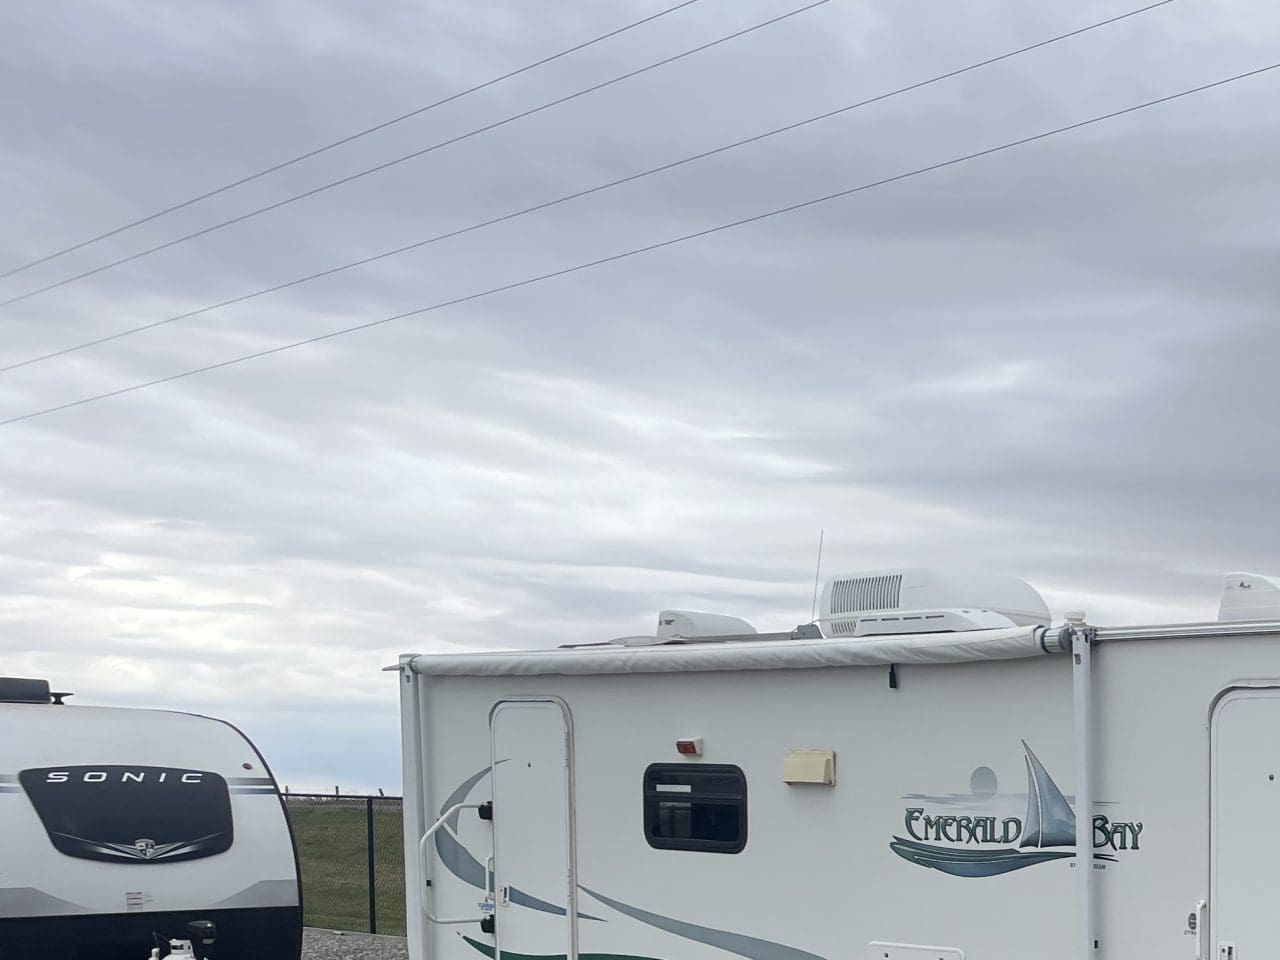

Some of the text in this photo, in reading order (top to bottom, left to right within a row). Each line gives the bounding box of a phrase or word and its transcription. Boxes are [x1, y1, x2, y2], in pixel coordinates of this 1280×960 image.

[46, 772, 203, 783] SONIC
[905, 808, 1143, 851] EMERALD BAY
